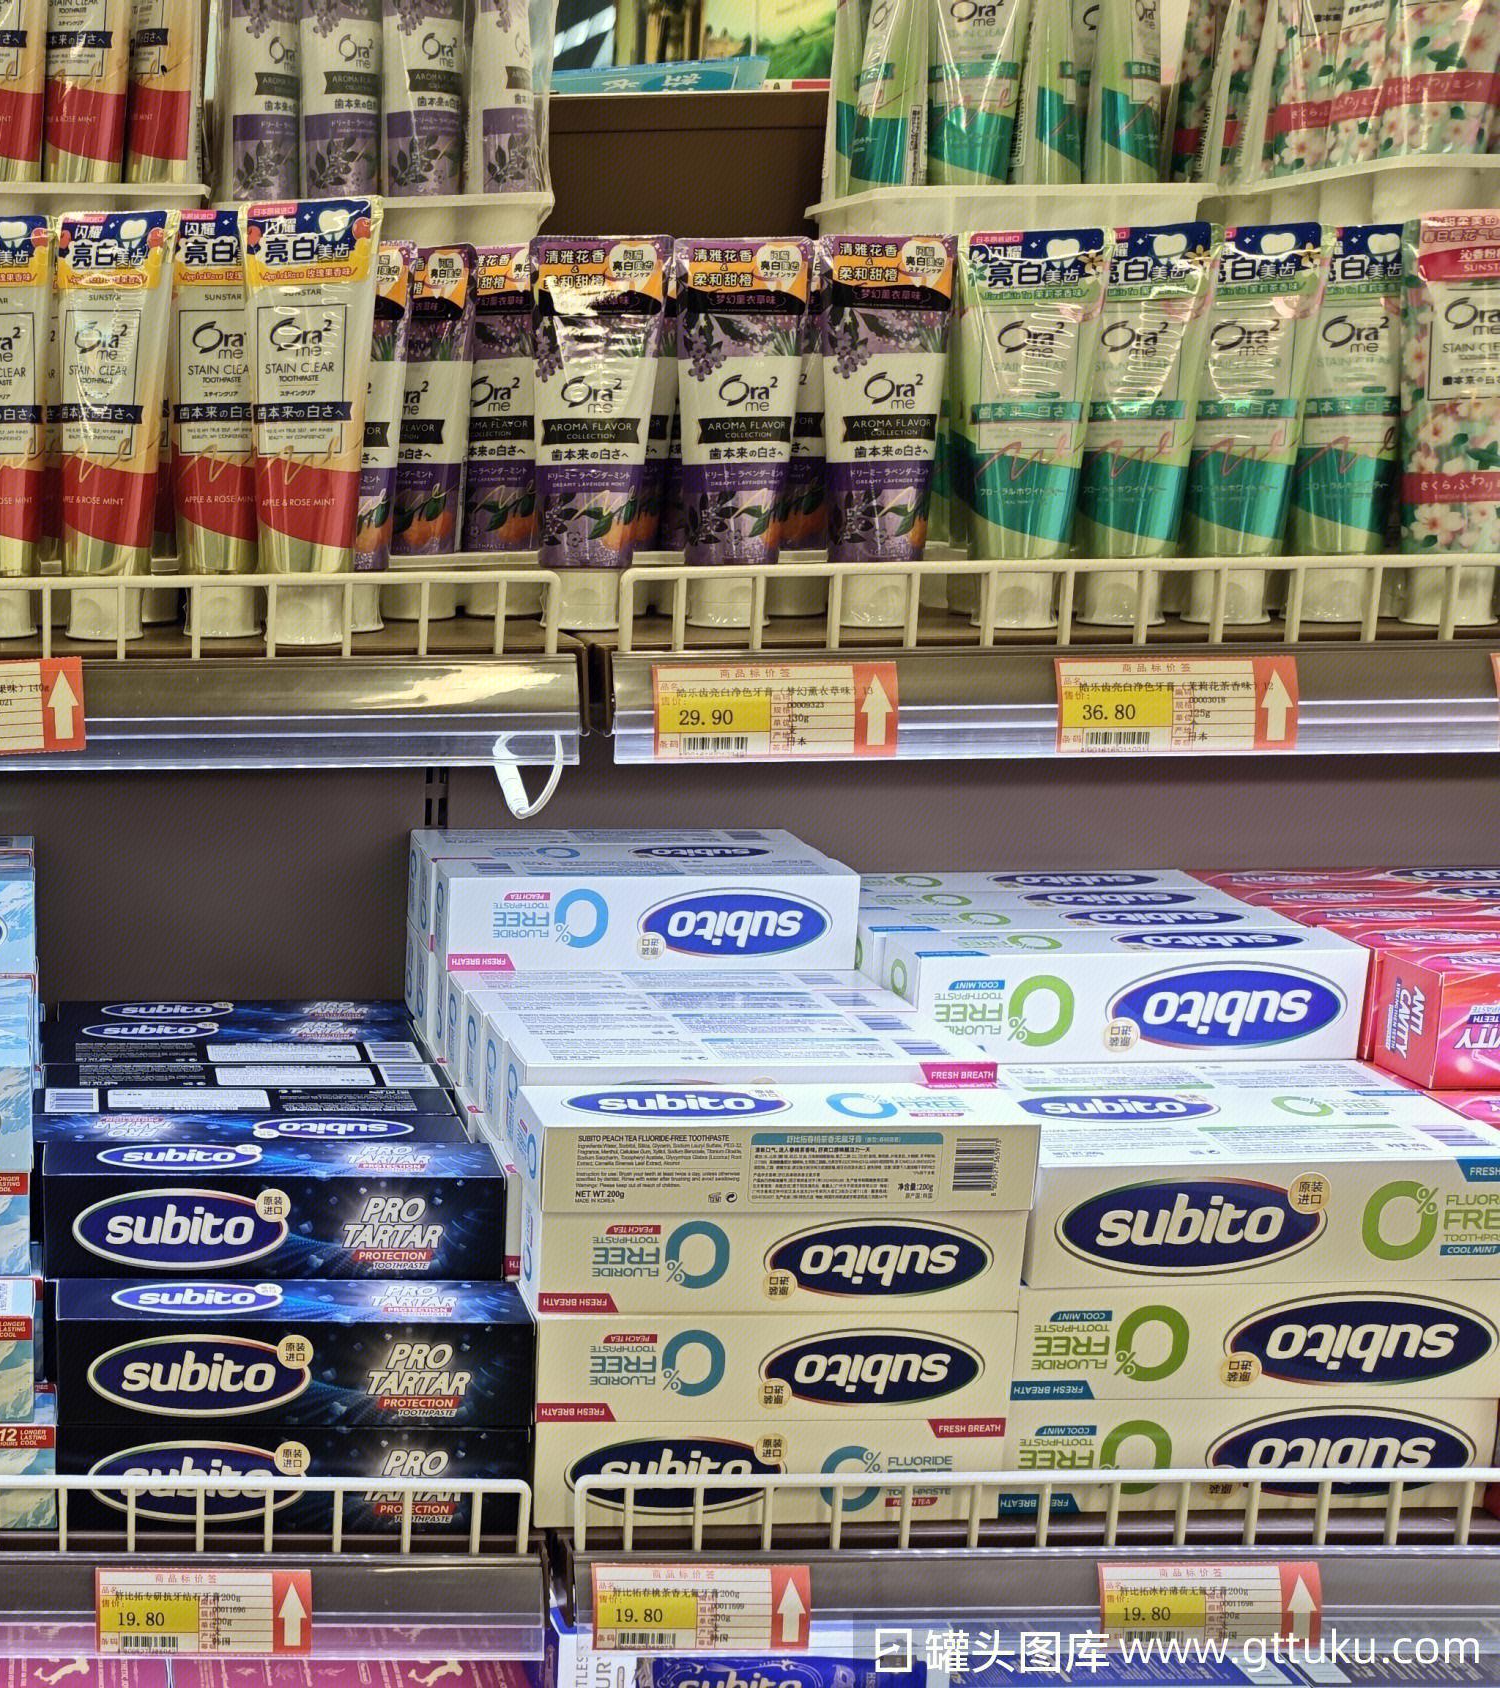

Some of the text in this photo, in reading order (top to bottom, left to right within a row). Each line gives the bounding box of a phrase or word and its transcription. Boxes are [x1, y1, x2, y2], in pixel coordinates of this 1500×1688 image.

[693, 247, 753, 264] 清雅花香
[838, 242, 899, 258] 清雅花香
[693, 272, 753, 288] 柔和甜橙
[1349, 340, 1380, 353] me
[279, 374, 319, 382] TOOTHPASTE
[744, 399, 770, 412] me
[707, 419, 787, 433] AROMA FLAVOR
[566, 431, 617, 441] COLLECTION
[708, 446, 785, 462] 歯本来の白さへ
[678, 709, 734, 726] 29.90
[1082, 704, 1136, 720] 36.80
[492, 911, 551, 928] FREE
[492, 928, 550, 939] FLUORIDE
[666, 908, 805, 949] subito
[451, 957, 507, 967] FRESH BREATH
[934, 1002, 1004, 1023] FREE
[1142, 989, 1314, 1037] subito
[1409, 985, 1426, 1036] ANTI
[1395, 988, 1412, 1060] CAVITY
[931, 1070, 996, 1081] FRESH BREATH
[596, 1091, 758, 1112] subito
[575, 1190, 625, 1199] NET WT 200g
[362, 1196, 427, 1225] PRO
[105, 1203, 256, 1246] subito
[1095, 1193, 1286, 1248] subito
[341, 1223, 446, 1250] TARTAR
[358, 1251, 427, 1261] PROTECTION
[800, 1242, 960, 1287] subito
[1033, 1336, 1111, 1357] FREE
[1264, 1321, 1460, 1374] subito
[387, 1343, 455, 1370] PRO
[121, 1350, 277, 1393] subito
[794, 1352, 952, 1395] subito
[365, 1370, 473, 1397] TARTAR
[938, 1424, 1002, 1434] FRESH BREATH
[118, 1612, 166, 1627] 19.80
[615, 1608, 663, 1623] 19.80
[1123, 1607, 1172, 1622] 19.80
